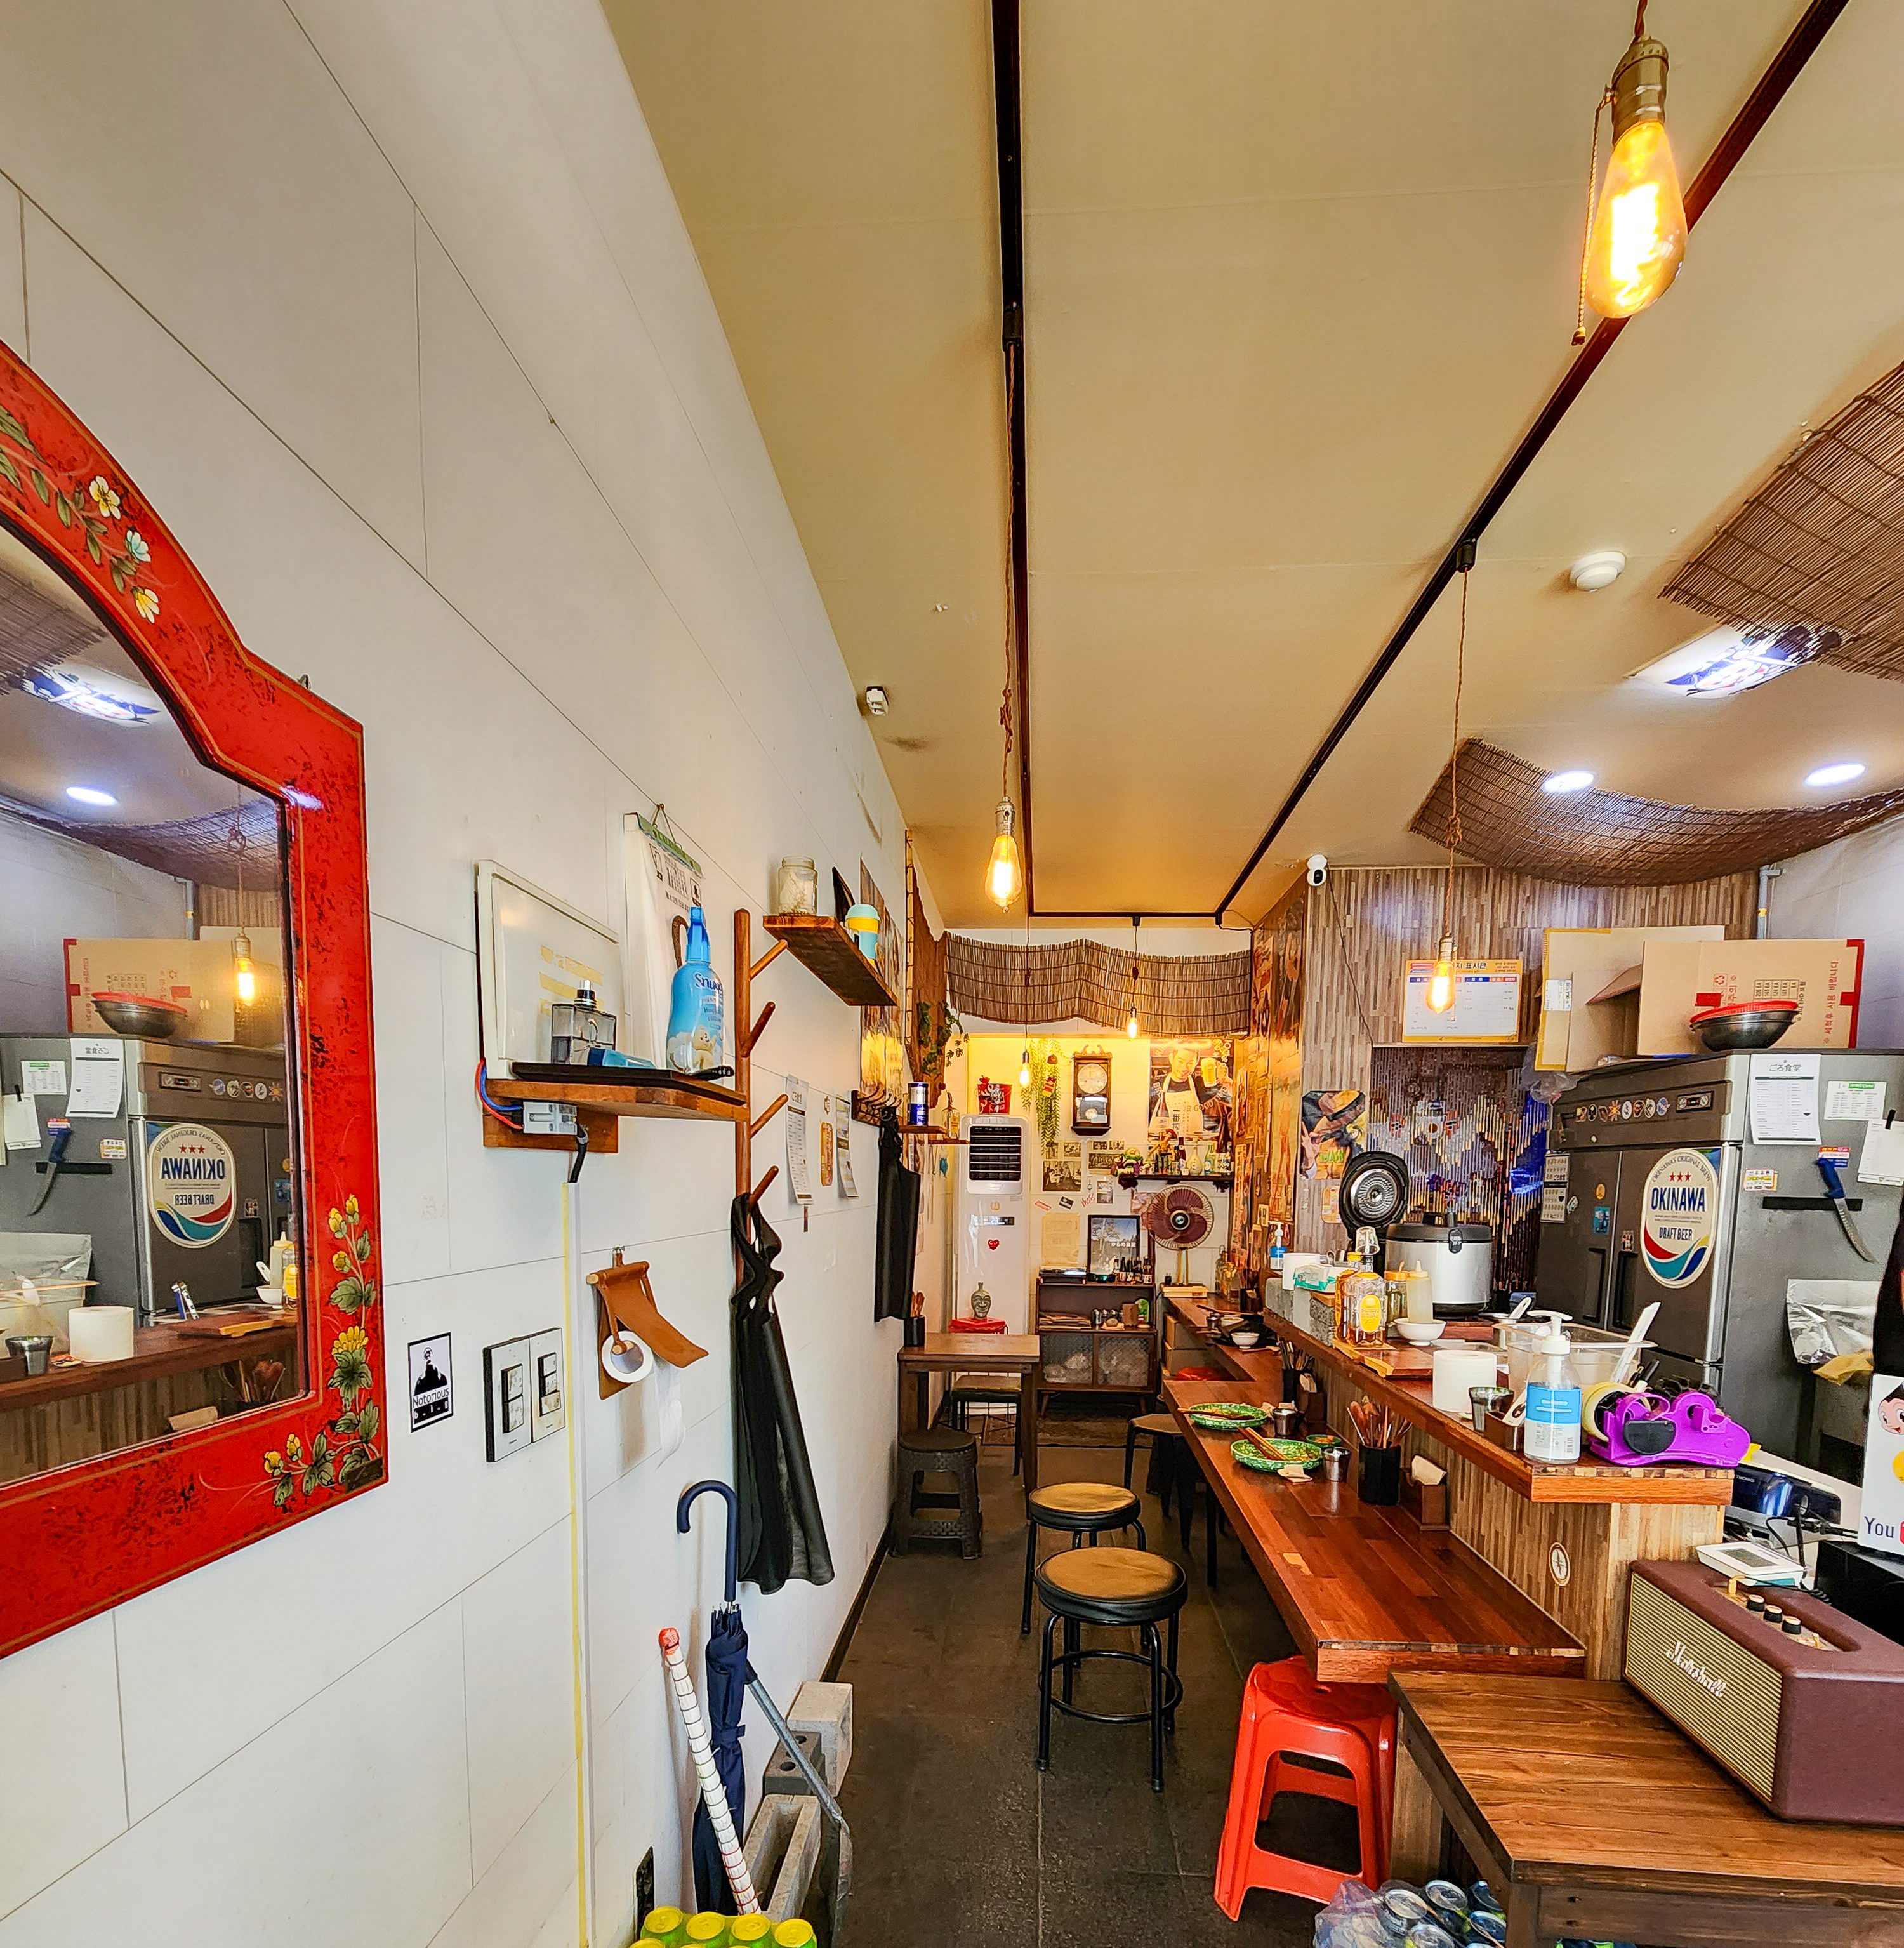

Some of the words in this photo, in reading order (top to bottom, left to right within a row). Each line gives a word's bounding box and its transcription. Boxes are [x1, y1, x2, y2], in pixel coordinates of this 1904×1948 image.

[1827, 994, 1836, 1009] 사용
[1651, 1187, 1706, 1212] OKINAWA
[1659, 1227, 1677, 1240] DRAFT
[1677, 1228, 1693, 1241] BEER
[413, 1388, 449, 1408] Notorious
[1864, 1516, 1894, 1539] You
[1665, 1640, 1726, 1699] Marshall
